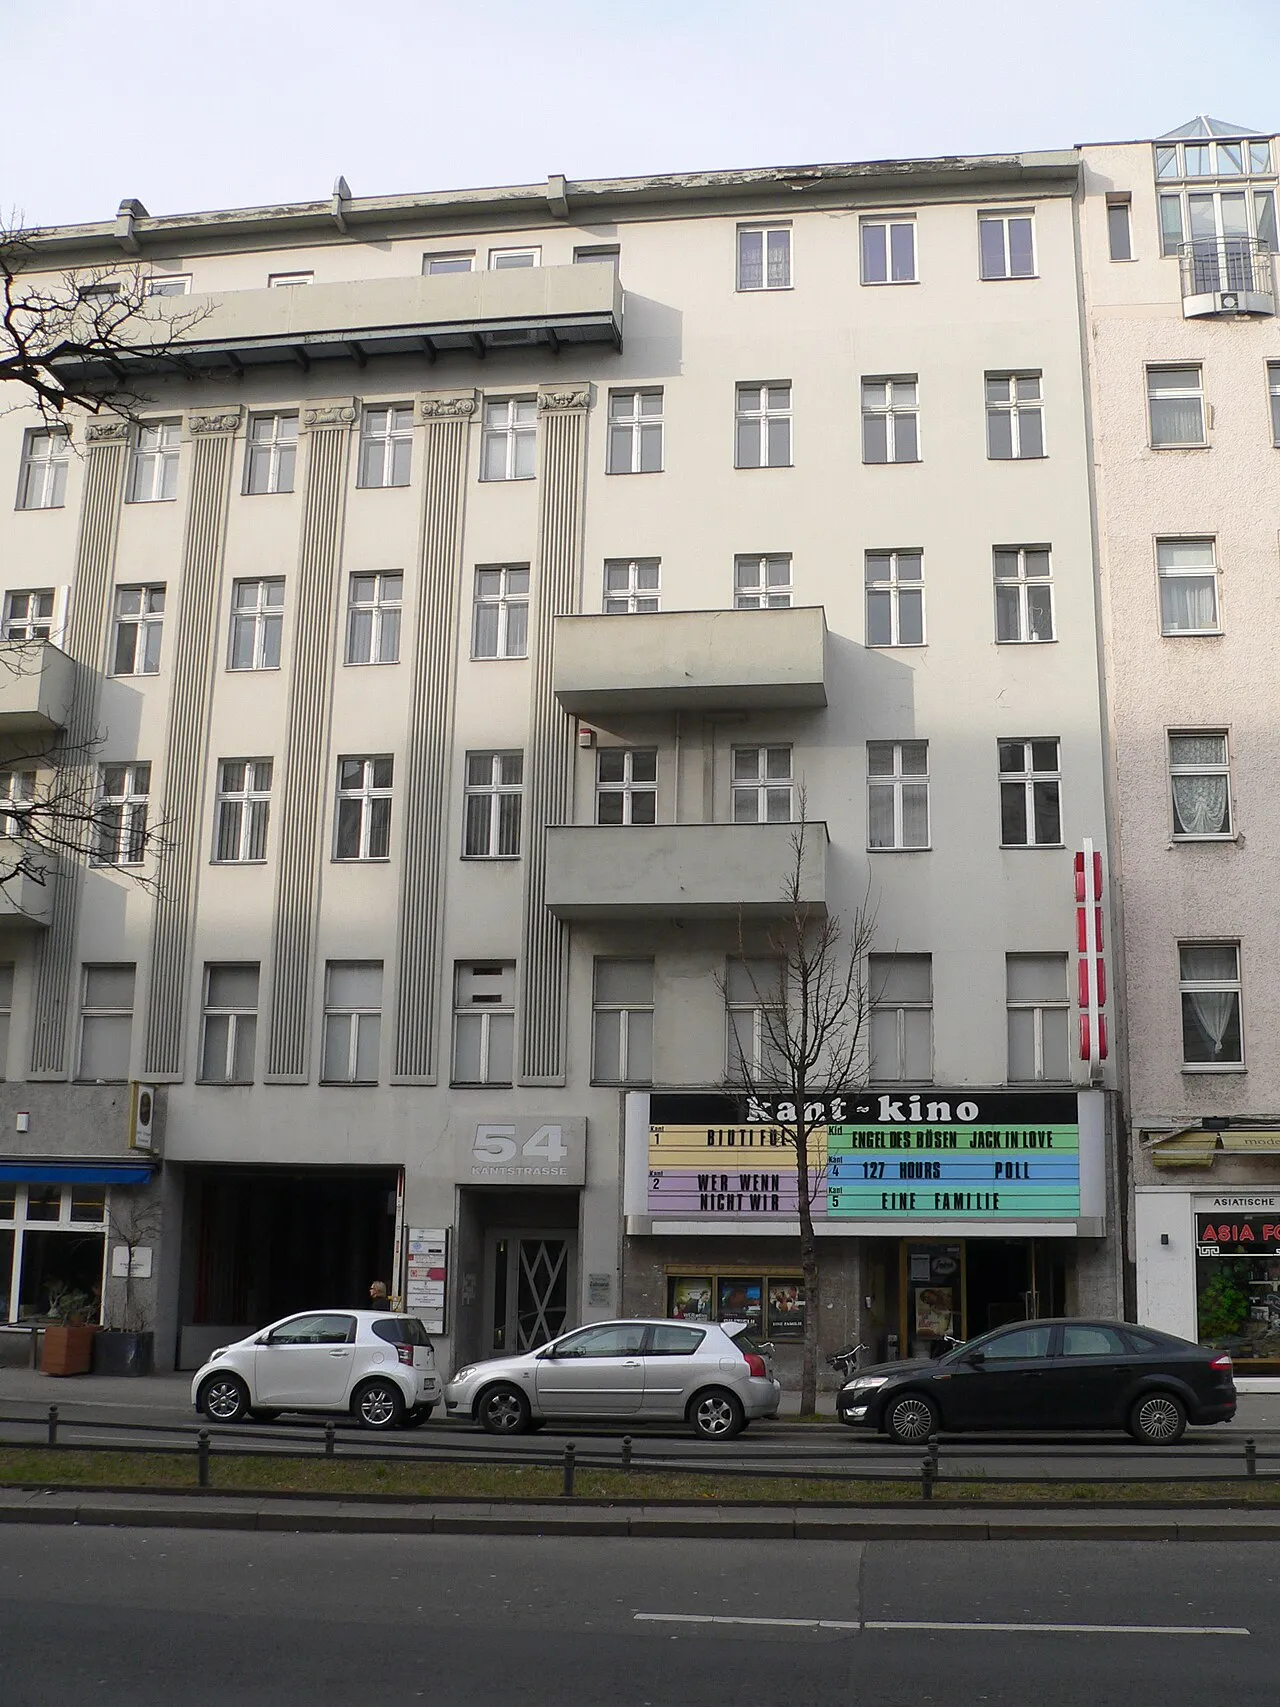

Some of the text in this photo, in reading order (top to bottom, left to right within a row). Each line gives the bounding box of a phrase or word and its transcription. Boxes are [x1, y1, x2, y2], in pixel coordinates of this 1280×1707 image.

[747, 1096, 847, 1122] kant
[877, 1094, 979, 1122] kino
[471, 1123, 568, 1163] 54
[654, 1133, 660, 1145] 1
[852, 1129, 957, 1149] ENGEL DES BÖSEN
[969, 1131, 1053, 1149] JACK IN LOVE
[471, 1166, 568, 1176] KANTSTRASSE
[832, 1165, 839, 1177] 4
[862, 1162, 941, 1179] 127 HOURS
[994, 1161, 1030, 1179] POLL
[652, 1178, 660, 1190] 2
[698, 1174, 779, 1191] WER WENN
[700, 1194, 779, 1211] NICHT WIR
[832, 1195, 839, 1207] 5
[881, 1193, 999, 1210] EINE FAMILIE
[1213, 1198, 1275, 1206] ASIATISCHE
[1202, 1224, 1255, 1241] ASIA
